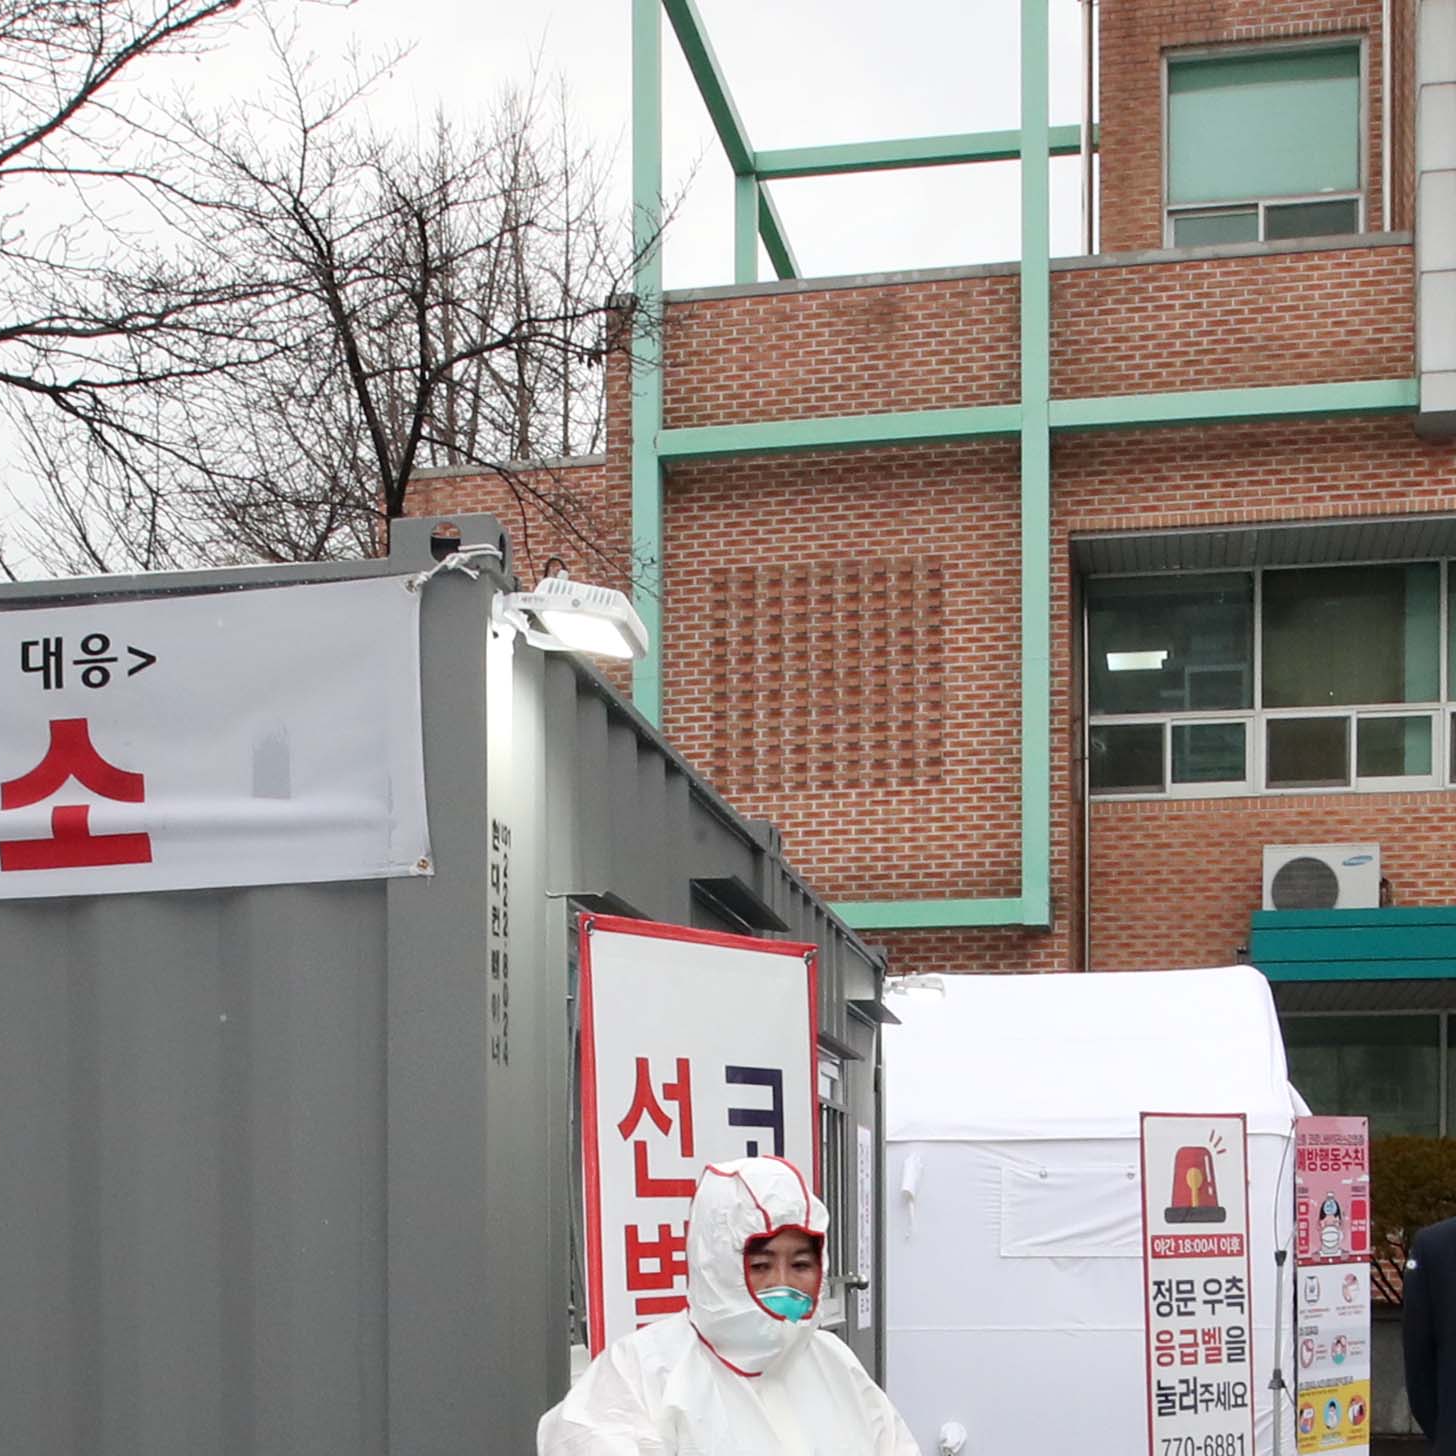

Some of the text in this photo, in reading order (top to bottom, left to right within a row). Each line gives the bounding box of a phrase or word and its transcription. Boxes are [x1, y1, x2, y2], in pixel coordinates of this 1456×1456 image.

[20, 632, 157, 690] 대응>
[1151, 1275, 1246, 1318] 정문 우측
[1154, 1325, 1247, 1368] 응급벨을
[1155, 1375, 1249, 1417] 눌러주세요
